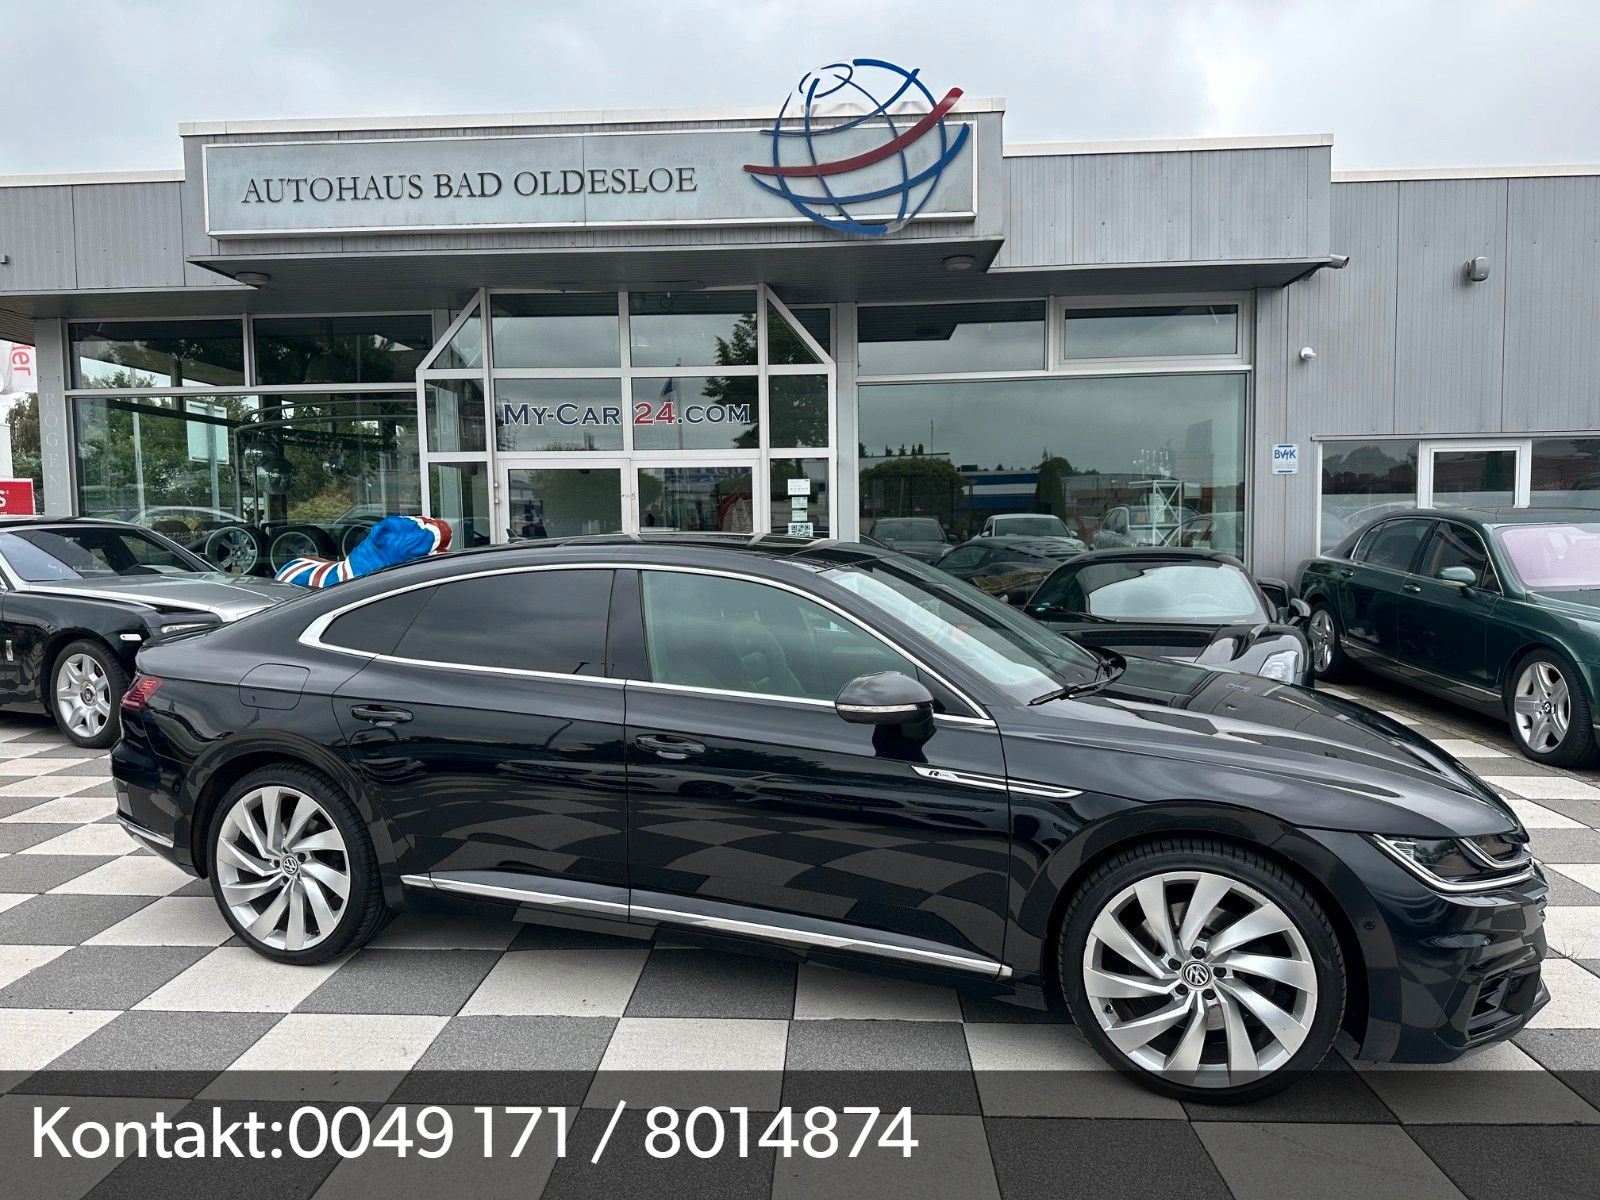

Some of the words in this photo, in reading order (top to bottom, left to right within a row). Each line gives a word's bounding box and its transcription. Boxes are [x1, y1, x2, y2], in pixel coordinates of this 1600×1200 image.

[241, 174, 424, 203] AUTOHAUS
[433, 172, 503, 198] BAD
[513, 167, 698, 196] OLDESLOE
